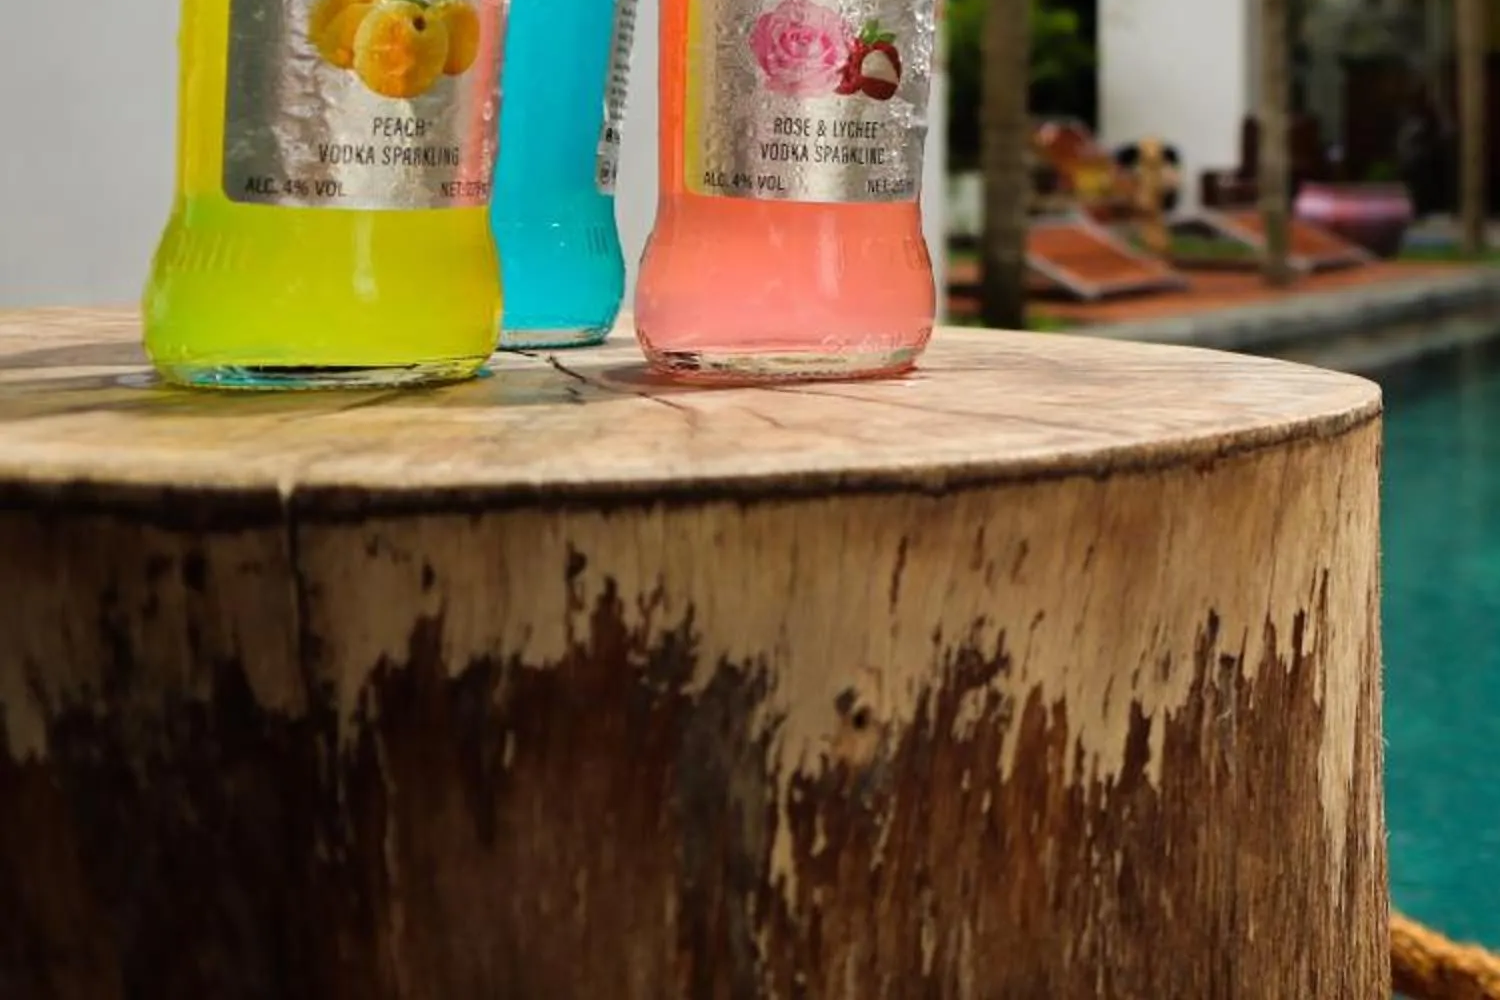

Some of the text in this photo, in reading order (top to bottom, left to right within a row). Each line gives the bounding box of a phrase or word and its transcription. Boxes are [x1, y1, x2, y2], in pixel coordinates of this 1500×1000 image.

[773, 116, 811, 137] ROSE
[818, 120, 828, 138] &
[318, 144, 460, 167] VODKA SPARKLING
[760, 143, 810, 163] VODKA
[314, 180, 347, 198] VOL
[756, 175, 786, 192] VOL
